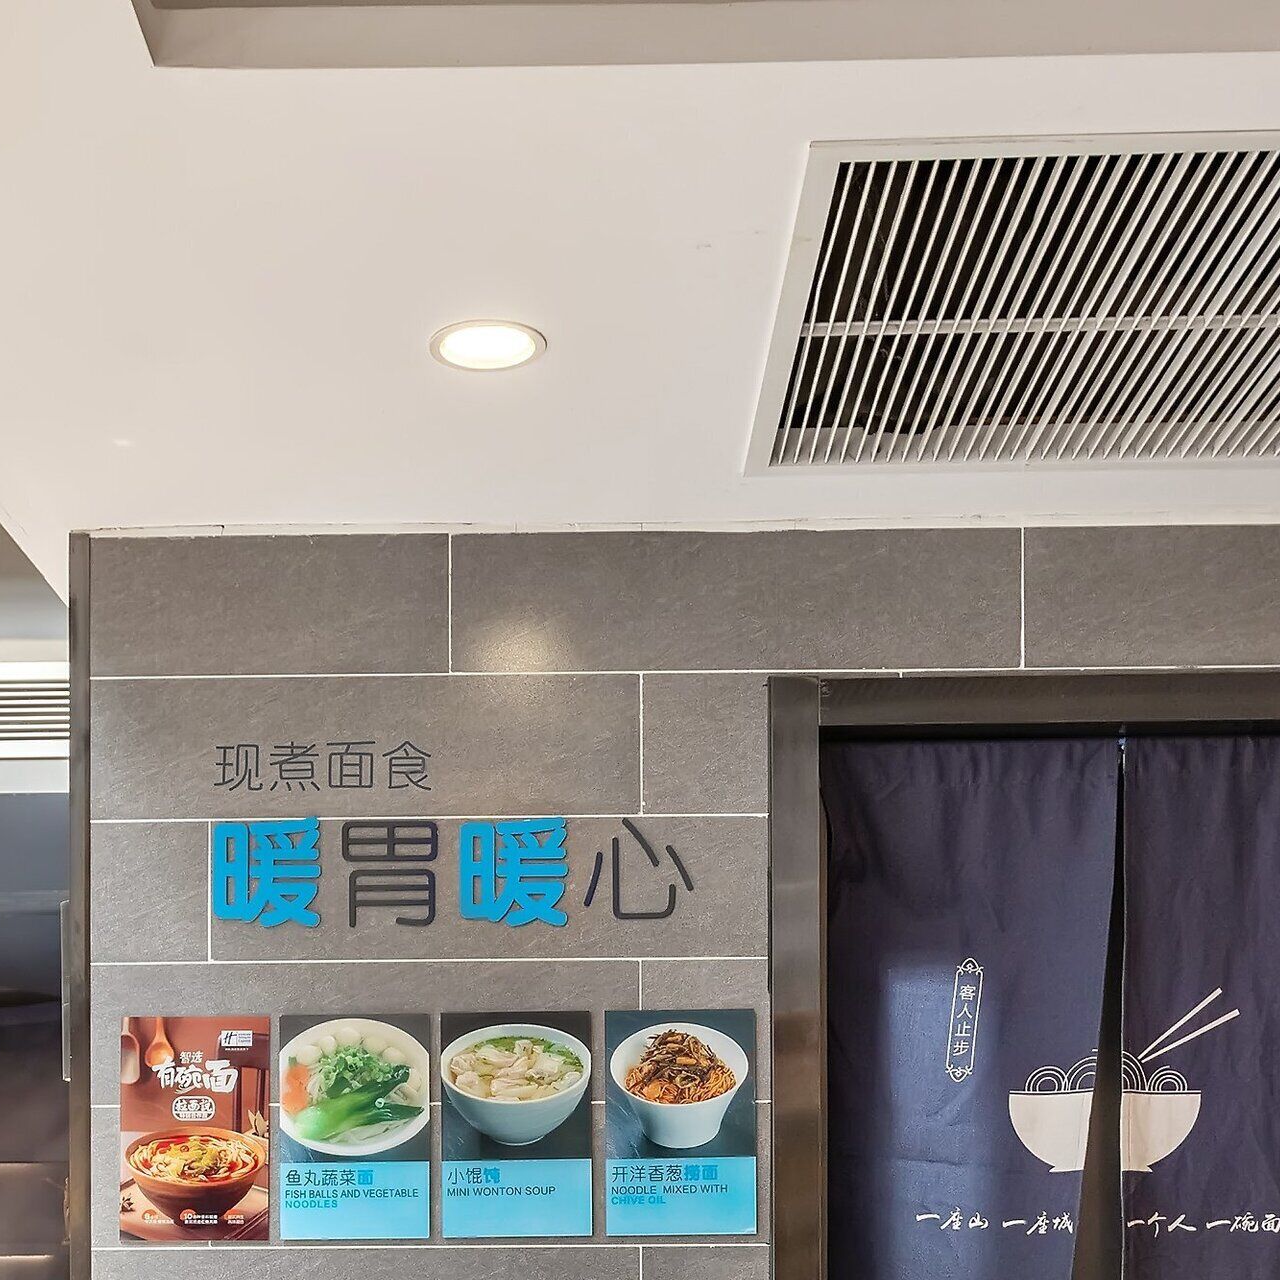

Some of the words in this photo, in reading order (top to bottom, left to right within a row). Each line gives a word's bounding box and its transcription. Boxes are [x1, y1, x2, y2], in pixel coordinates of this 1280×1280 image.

[214, 741, 431, 791] 现煮面食
[212, 816, 694, 928] 暖胃暖心
[953, 985, 976, 1056] 客人止步
[151, 1056, 238, 1093] 有碗面
[285, 1169, 374, 1186] 鱼丸蔬菜面
[447, 1167, 501, 1184] 小馄饨
[285, 1189, 306, 1199] FISH
[308, 1189, 338, 1198] BALLS
[340, 1189, 361, 1198] AND
[363, 1188, 419, 1198] VEGETABLE
[447, 1187, 470, 1197] MINI
[473, 1187, 522, 1196] WONTON
[525, 1186, 556, 1195] SOUP
[611, 1185, 657, 1195] NOODLE
[663, 1185, 698, 1194] MIXED
[700, 1184, 728, 1193] WITH
[285, 1200, 338, 1208] NOODLES
[611, 1196, 645, 1205] CHIVE
[648, 1195, 666, 1204] OIL
[915, 1207, 989, 1230] 一座山
[1002, 1211, 1074, 1236] 一座城
[1127, 1212, 1197, 1238] 一个人
